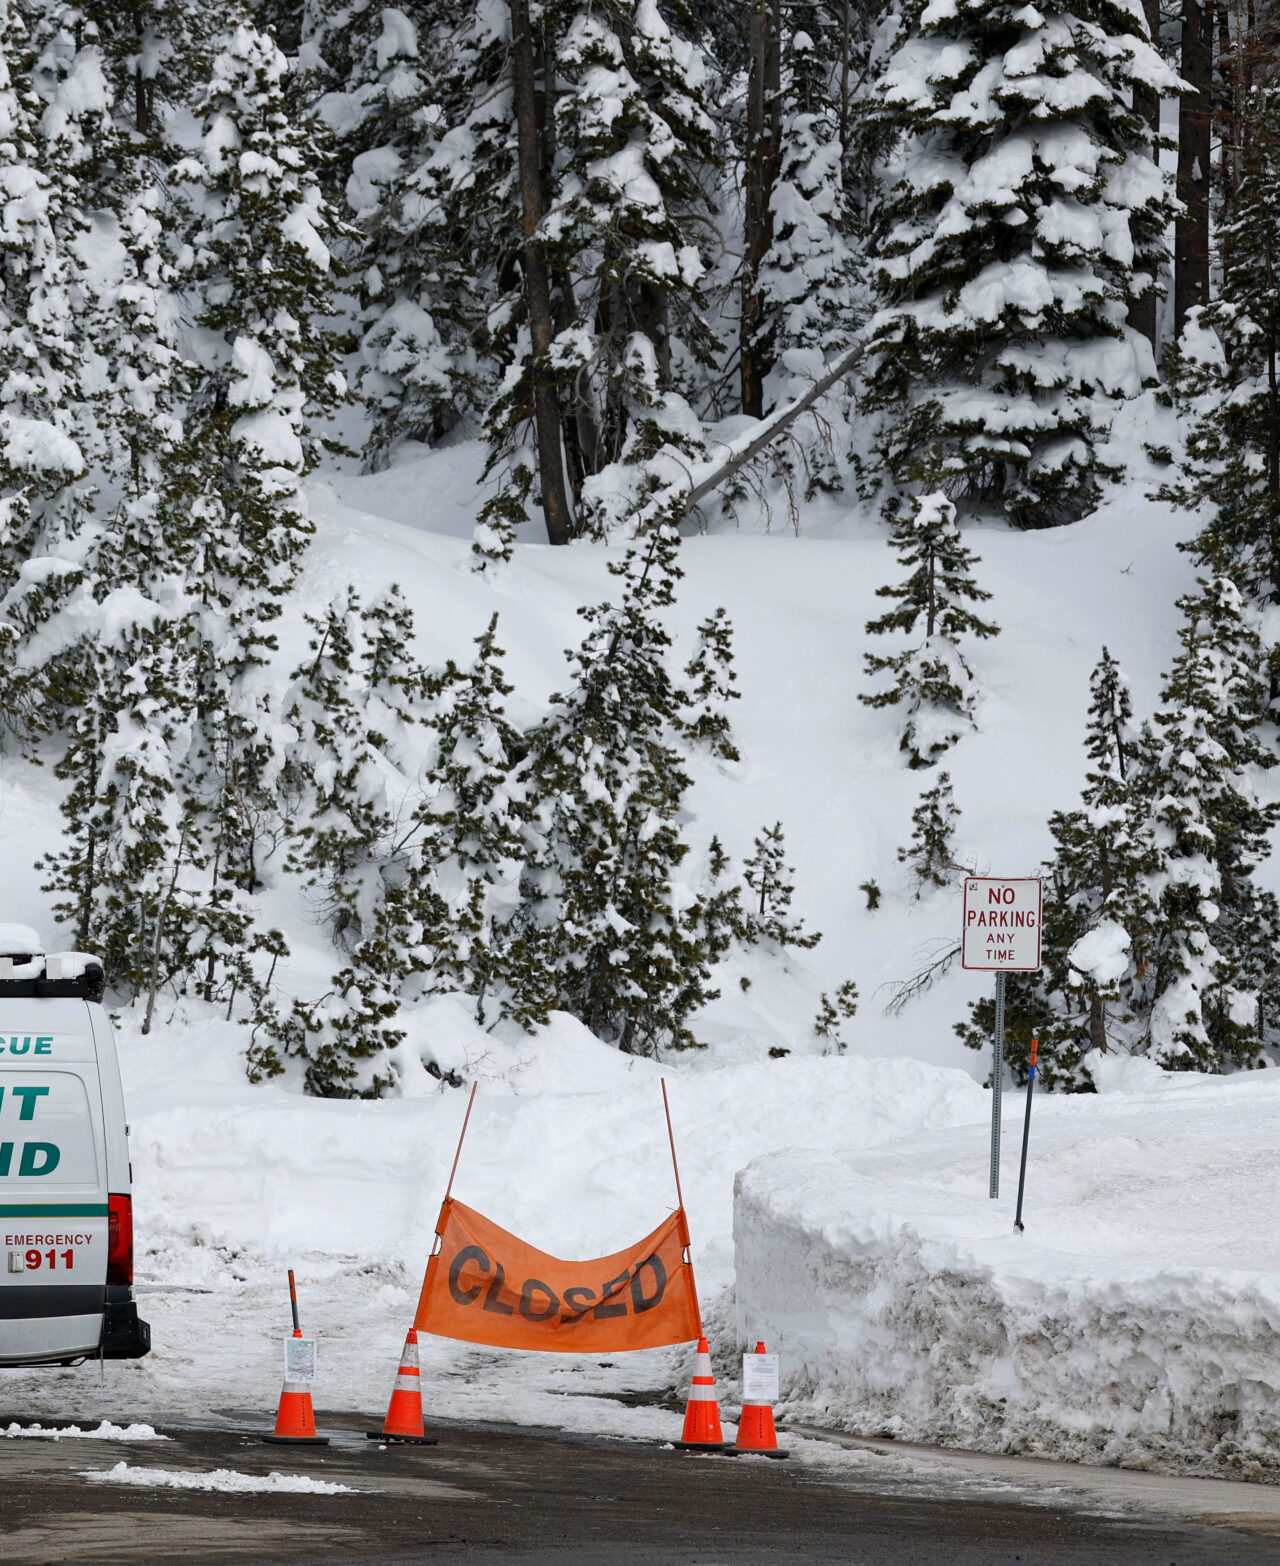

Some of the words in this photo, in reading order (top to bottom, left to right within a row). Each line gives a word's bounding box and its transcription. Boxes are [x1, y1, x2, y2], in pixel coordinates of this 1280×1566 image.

[988, 887, 1016, 905] NO
[967, 910, 1036, 928] PARKING
[986, 933, 1016, 944] ANY
[985, 949, 1016, 961] TIME
[4, 1234, 93, 1246] EMERGENCY
[24, 1248, 74, 1270] 911
[448, 1244, 669, 1325] CLOSED
